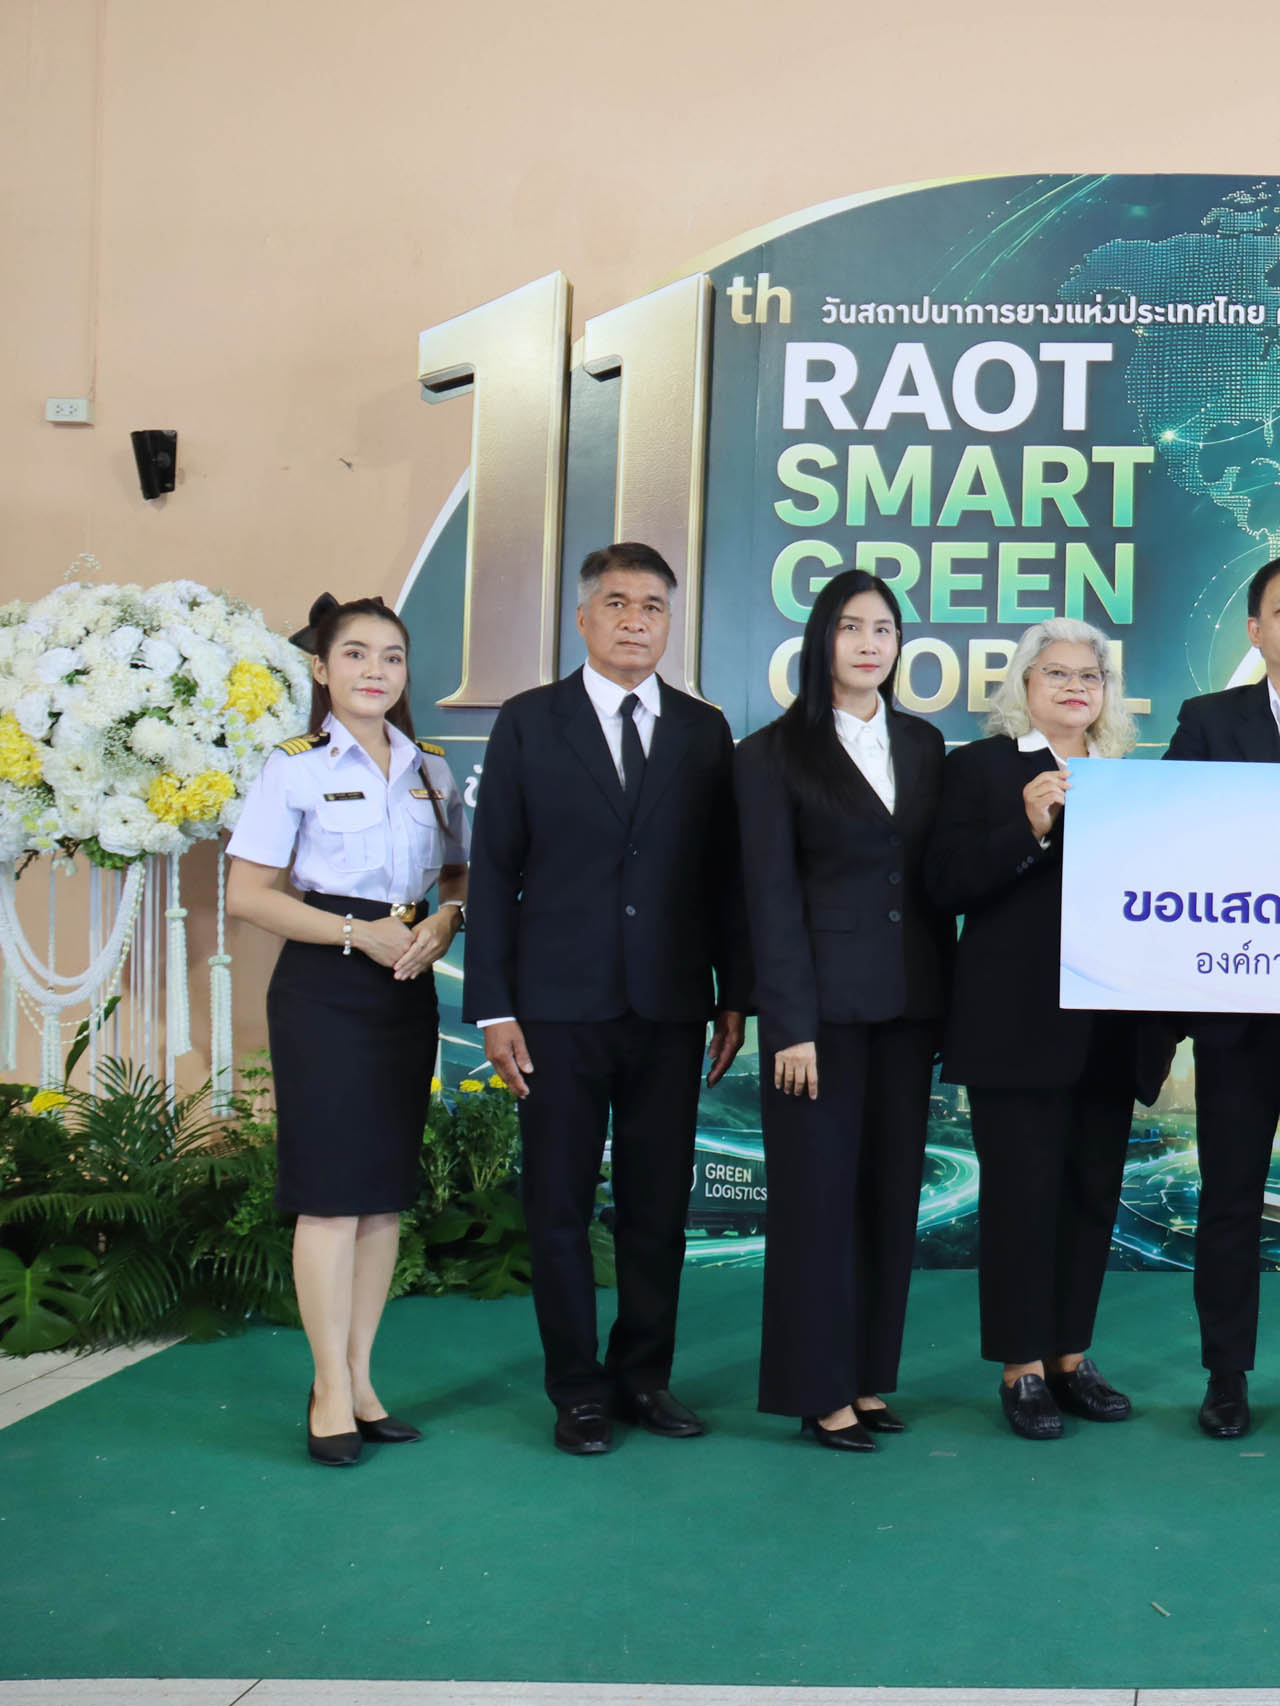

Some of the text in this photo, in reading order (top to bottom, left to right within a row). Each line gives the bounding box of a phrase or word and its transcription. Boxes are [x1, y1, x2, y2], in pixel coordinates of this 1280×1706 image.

[822, 295, 1265, 325] วันสถาปนาการยางแห่งประเทศไทย
[781, 341, 1113, 431] RAOT
[773, 444, 1154, 528] SMART
[770, 540, 1135, 625] GREEN
[704, 1182, 768, 1201] LOGISTICS
[705, 1162, 752, 1183] GREEN
